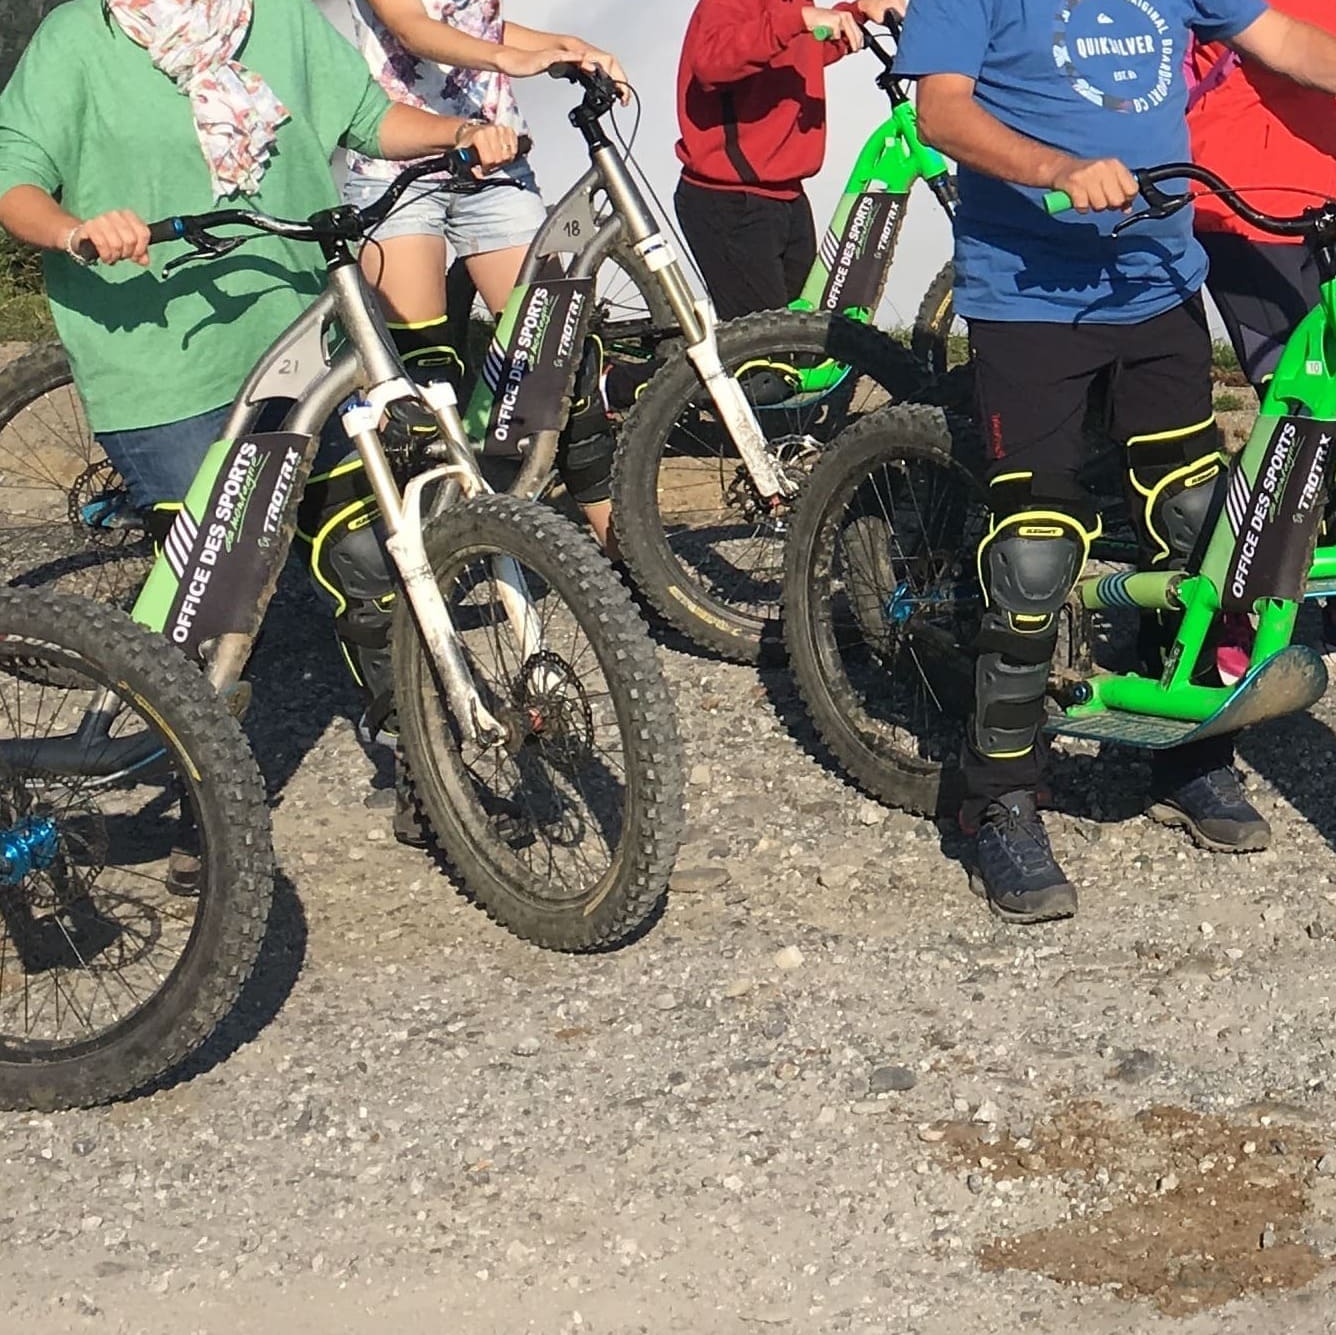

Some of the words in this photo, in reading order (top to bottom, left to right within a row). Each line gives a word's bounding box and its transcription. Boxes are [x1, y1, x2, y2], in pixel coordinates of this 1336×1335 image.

[1148, 38, 1173, 106] BOARDSORT
[563, 220, 580, 237] 18
[826, 266, 849, 309] OFFICE
[840, 241, 856, 266] DES
[848, 196, 874, 241] SPORTS
[877, 201, 900, 251] TROTRX
[518, 287, 548, 348] SPORTS
[557, 290, 583, 357] TROTRX
[279, 359, 299, 375] 21
[509, 349, 528, 382] DES
[495, 383, 519, 441] OFFICE
[263, 446, 299, 533] TROTRX
[1297, 433, 1332, 510] TROTRX
[173, 570, 212, 643] OFFICE
[200, 523, 226, 566] DES
[215, 442, 257, 521] SPORTS
[1232, 530, 1259, 598] OFFICE
[1251, 493, 1270, 532] DES
[1263, 422, 1296, 492] SPORTS
